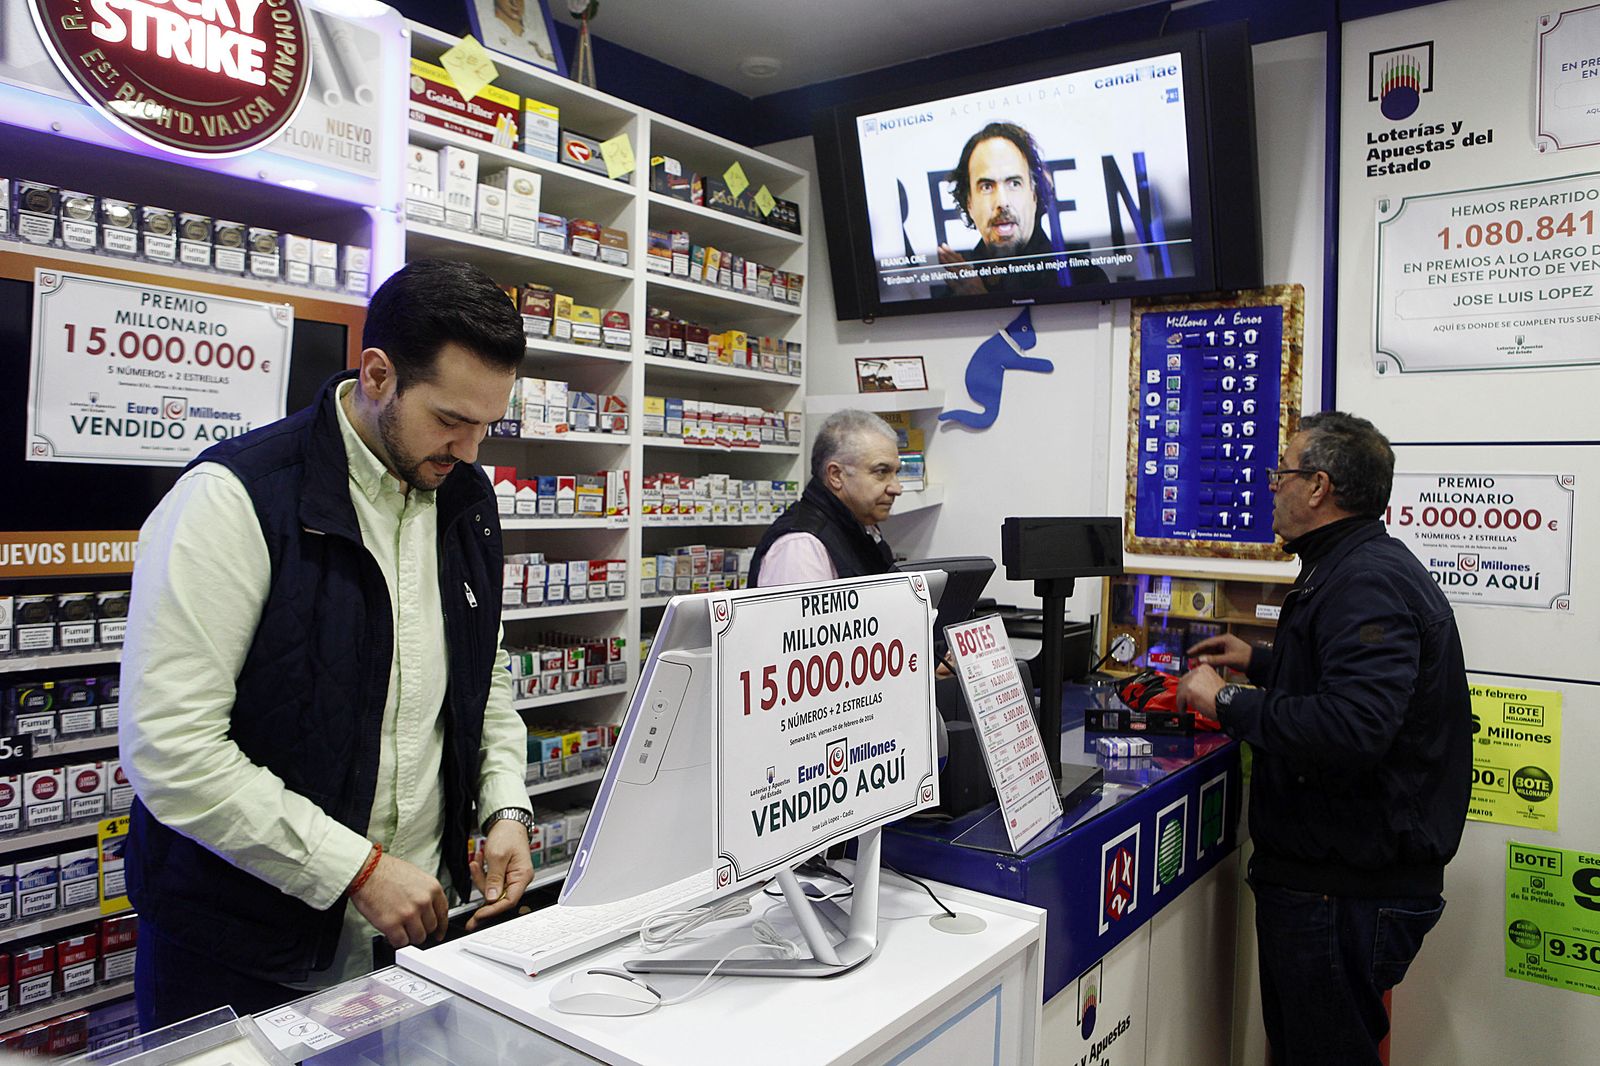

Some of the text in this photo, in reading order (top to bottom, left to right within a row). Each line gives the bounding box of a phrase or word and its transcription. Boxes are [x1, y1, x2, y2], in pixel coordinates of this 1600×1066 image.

[91, 0, 267, 86] STRIKE
[1561, 61, 1577, 72] EN
[1582, 68, 1598, 79] EN
[425, 89, 495, 120] Golden Filter
[880, 84, 1077, 132] NOTICIAS ACTUALIDAD
[326, 117, 373, 145] NUEVO
[1367, 120, 1463, 145] Loterías y
[284, 127, 372, 164] FLOW FILTER
[1367, 129, 1493, 162] Apuestas del
[1367, 157, 1431, 178] Estado
[1451, 189, 1599, 218] HEMOS REPARTIDO
[1437, 209, 1596, 250] 1.080.841
[880, 254, 927, 268] FRANCIA CINE
[921, 274, 930, 284] de
[959, 267, 978, 279] César
[979, 265, 991, 277] del
[992, 264, 1008, 275] cine
[1008, 260, 1035, 274] francés
[1036, 261, 1044, 271] al
[1045, 259, 1068, 273] mejor
[1069, 256, 1089, 268] filme
[1091, 253, 1133, 269] extranjero
[1403, 246, 1587, 275] EN PREMIOS A LO LARGO
[1428, 259, 1600, 285] EN ESTE PUNTO DE VEN
[140, 292, 208, 314] PREMIO
[1453, 285, 1594, 307] JOSE LUIS LOPEZ
[115, 310, 228, 337] MILLONARIO
[1166, 312, 1262, 328] Millones de Euros
[1433, 321, 1454, 333] AQUÍ
[1456, 322, 1466, 331] ES
[1467, 321, 1499, 330] DONDE
[1513, 318, 1556, 328] CUMPLEN
[1557, 316, 1575, 325] TUS
[63, 323, 271, 373] 15.000.000 €
[1223, 354, 1258, 370] 9,3
[107, 365, 114, 374] 5
[116, 365, 166, 379] NÚMEROS
[175, 372, 182, 380] 2
[183, 373, 230, 385] ESTRELLAS
[1222, 376, 1257, 393] 0,3
[127, 402, 159, 415] Euro
[189, 406, 242, 421] Millones
[1222, 399, 1256, 416] 9,6
[71, 415, 185, 440] VENDIDO
[1145, 369, 1161, 475] BOTES
[1222, 422, 1255, 439] 9,6
[1222, 444, 1254, 461] 1,7
[1438, 477, 1495, 489] PREMIO
[1419, 492, 1514, 505] MILLONARIO
[1219, 511, 1252, 530] 1,1
[1385, 506, 1558, 531] 15.000.000 €
[1421, 530, 1461, 541] NÚMEROS
[1475, 534, 1517, 543] ESTRELLAS
[1430, 558, 1530, 572] Euro Millones
[1486, 572, 1541, 590] AQUÍ
[801, 590, 859, 618] PREMIO
[64, 627, 91, 635] Fumar
[783, 616, 879, 653] MILLONARIO
[955, 624, 996, 657] BOTES
[740, 638, 918, 716] 15.000.000 €
[1470, 688, 1527, 701] de febrero
[780, 719, 786, 732] 5
[788, 706, 828, 730] NÚMEROS
[835, 703, 841, 715] 2
[842, 692, 883, 713] ESTRELLAS
[1506, 715, 1541, 724] MILLONARIO
[1509, 705, 1540, 717] BOTE
[20, 719, 51, 728] Fumar
[789, 735, 806, 746] Semana
[805, 731, 818, 742] 8/16,
[818, 727, 832, 736] viernes
[832, 724, 838, 732] 26
[838, 722, 843, 730] de
[843, 718, 859, 729] febrero
[864, 713, 875, 722] 2016
[1488, 726, 1552, 744] Millones
[798, 737, 896, 784] Euro Millones
[771, 778, 791, 791] Apuestas
[1497, 777, 1505, 788] €
[1515, 777, 1550, 791] BOTE
[751, 748, 906, 837] VENDIDO AQUÍ
[767, 789, 783, 799] Estado
[1516, 787, 1550, 799] MILLONARIO
[30, 805, 60, 814] Fumar
[73, 798, 101, 807] Fumar
[811, 823, 820, 832] Jose
[820, 820, 828, 829] Luis
[828, 815, 840, 825] Lopez
[1514, 852, 1600, 869] BOTE Este
[24, 893, 54, 905] Fumar
[1530, 894, 1565, 907] Primitiva
[1531, 888, 1554, 898] Gordo
[66, 968, 92, 979] Fumar
[1526, 970, 1558, 983] Primitiva
[1527, 964, 1547, 973] Gordo
[22, 981, 49, 993] Fumar
[274, 1013, 296, 1025] NO
[1089, 1014, 1131, 1063] Apuestas
